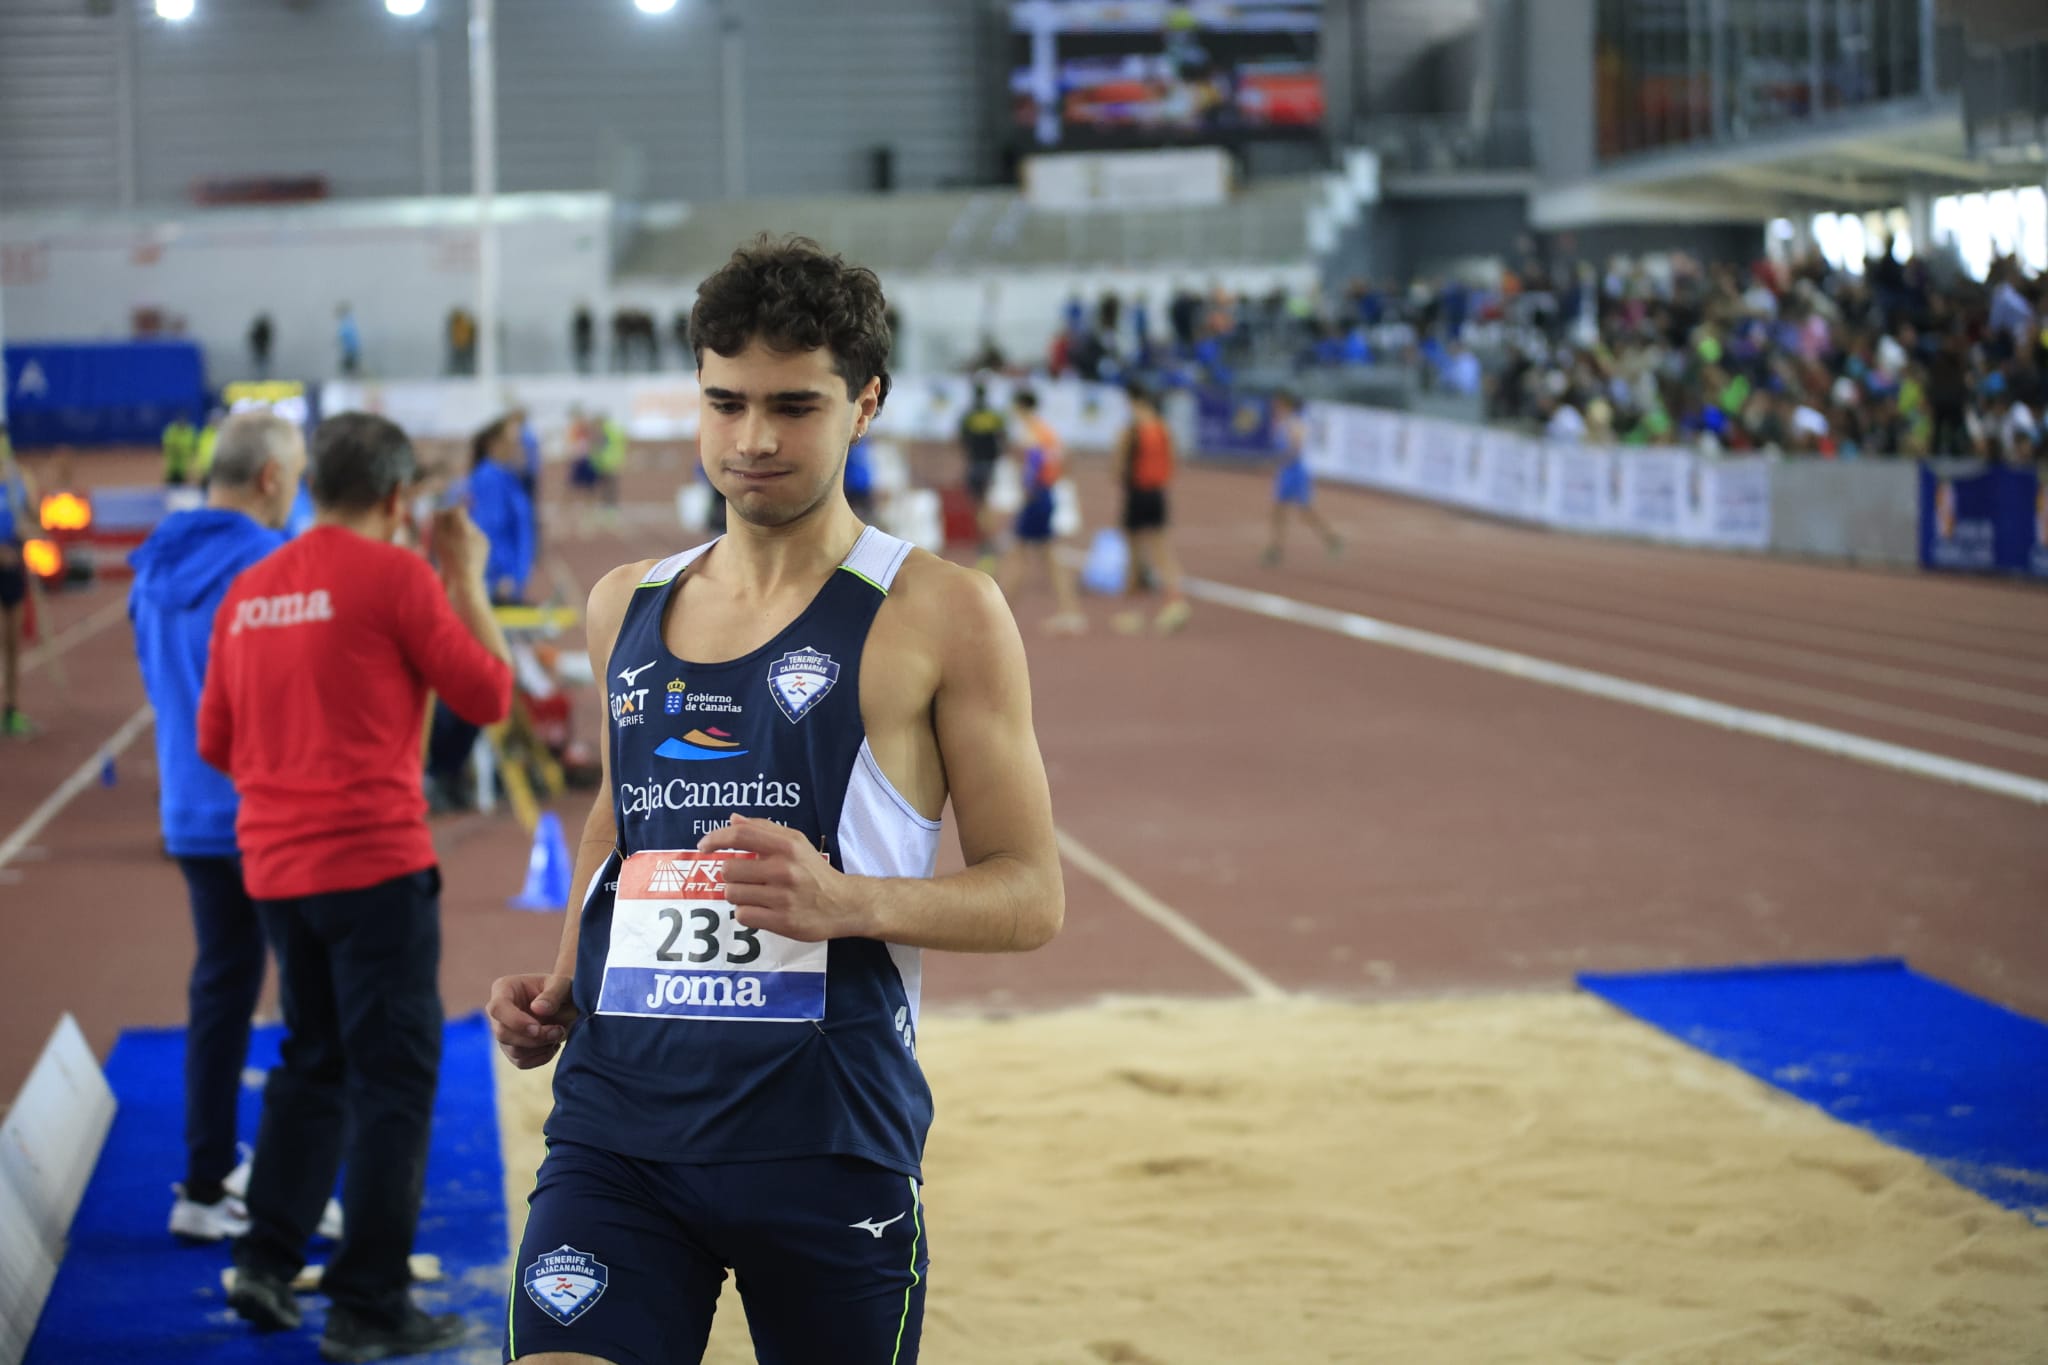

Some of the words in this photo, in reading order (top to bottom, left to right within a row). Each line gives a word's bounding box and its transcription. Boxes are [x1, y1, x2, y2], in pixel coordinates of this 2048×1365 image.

[789, 655, 823, 665] TENERIFE
[780, 664, 828, 674] CAJACANARIAS
[686, 693, 732, 703] Gobierno
[685, 702, 697, 711] de
[699, 702, 742, 712] Canarias
[620, 773, 801, 820] CajaCanarias
[604, 881, 618, 892] TE
[656, 907, 761, 964] 233
[544, 1255, 586, 1266] TENERIFE
[535, 1264, 595, 1277] CAJACANARIAS
